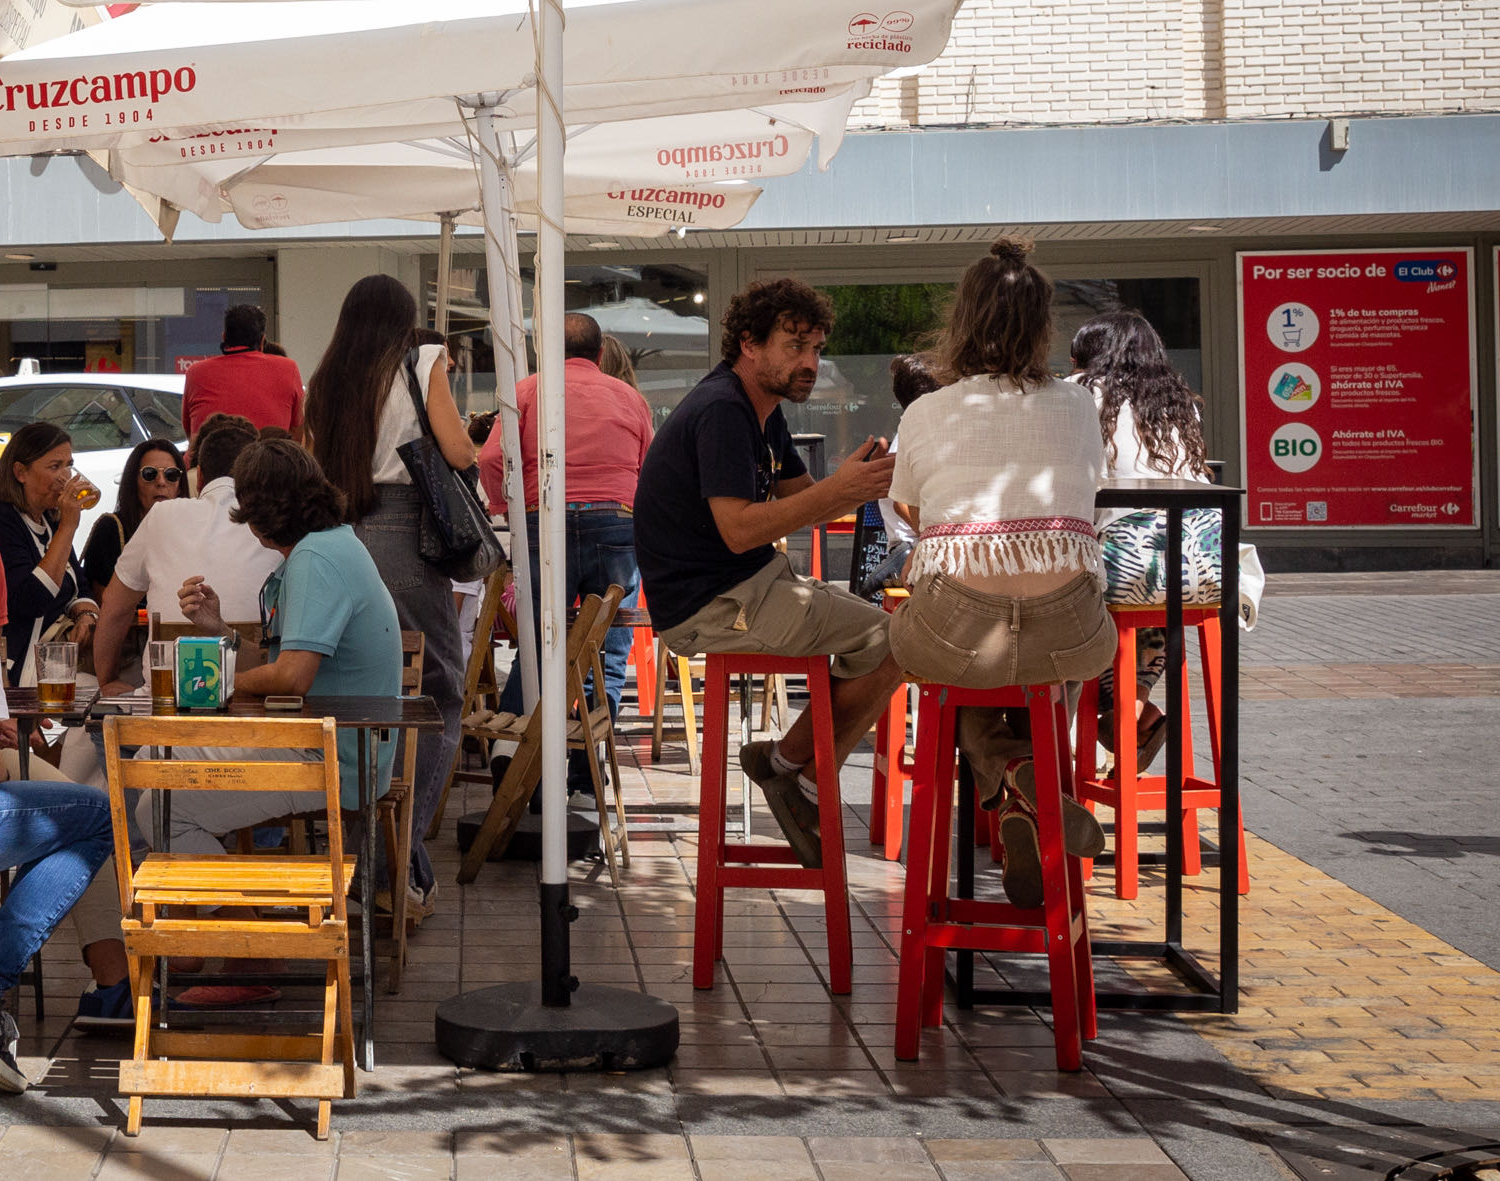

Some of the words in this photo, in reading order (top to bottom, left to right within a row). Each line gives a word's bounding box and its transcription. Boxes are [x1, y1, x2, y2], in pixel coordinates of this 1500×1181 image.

[847, 39, 912, 53] reciclado
[29, 115, 89, 133] DESDE
[104, 108, 155, 126] 1904
[181, 142, 226, 158] DESDE
[237, 138, 274, 151] 1904
[627, 205, 696, 224] ESPECIAL
[1252, 264, 1284, 280] Por
[1286, 266, 1314, 280] ser
[1316, 263, 1361, 279] socio
[1364, 263, 1387, 278] de
[1398, 266, 1408, 277] El
[1410, 265, 1434, 277] Club
[1282, 307, 1304, 328] 1%
[1329, 308, 1346, 318] 1%
[1347, 308, 1360, 317] de
[1361, 307, 1377, 317] tus
[1378, 308, 1419, 319] compras
[1330, 379, 1372, 390] ahórrate
[1373, 379, 1383, 389] el
[1385, 379, 1404, 389] IVA
[1332, 430, 1375, 439] Ahórrate
[1376, 429, 1385, 439] el
[1386, 429, 1405, 438] IVA
[1274, 438, 1318, 457] BIO
[1389, 503, 1438, 513] Carrefour
